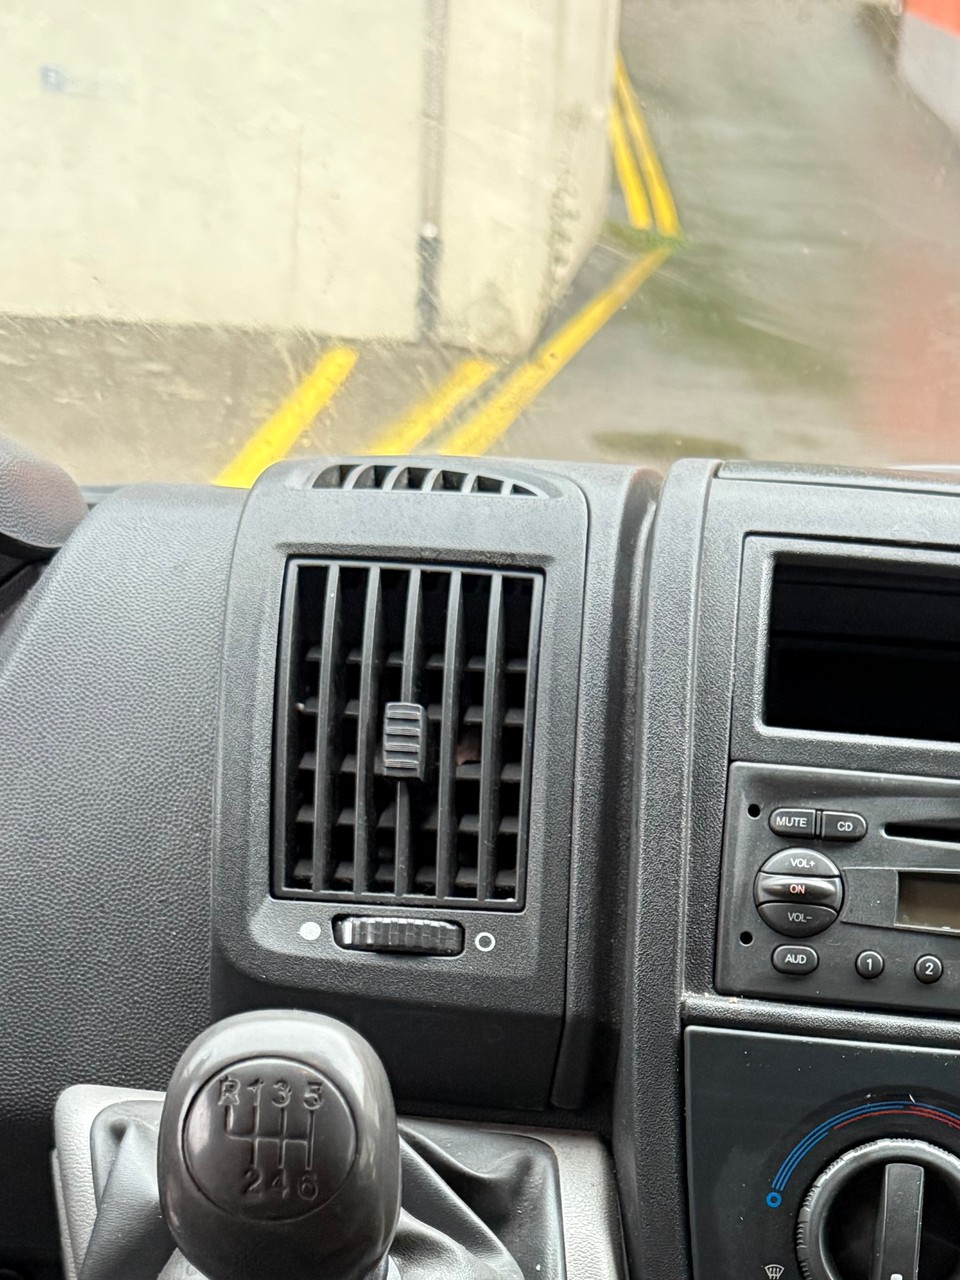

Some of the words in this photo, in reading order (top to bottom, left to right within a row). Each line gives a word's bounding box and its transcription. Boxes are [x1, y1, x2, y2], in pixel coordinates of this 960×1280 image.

[776, 816, 807, 828] MUTE
[837, 821, 853, 832] CD
[790, 858, 815, 868] VOL+
[790, 884, 805, 894] ON
[785, 954, 807, 965] AUD
[866, 958, 873, 971] 1
[925, 963, 934, 975] 2
[217, 1075, 241, 1106] R
[247, 1078, 264, 1107] 1
[272, 1079, 292, 1108] 3
[302, 1080, 323, 1110] 5
[243, 1168, 264, 1199] 2
[297, 1172, 319, 1201] 6
